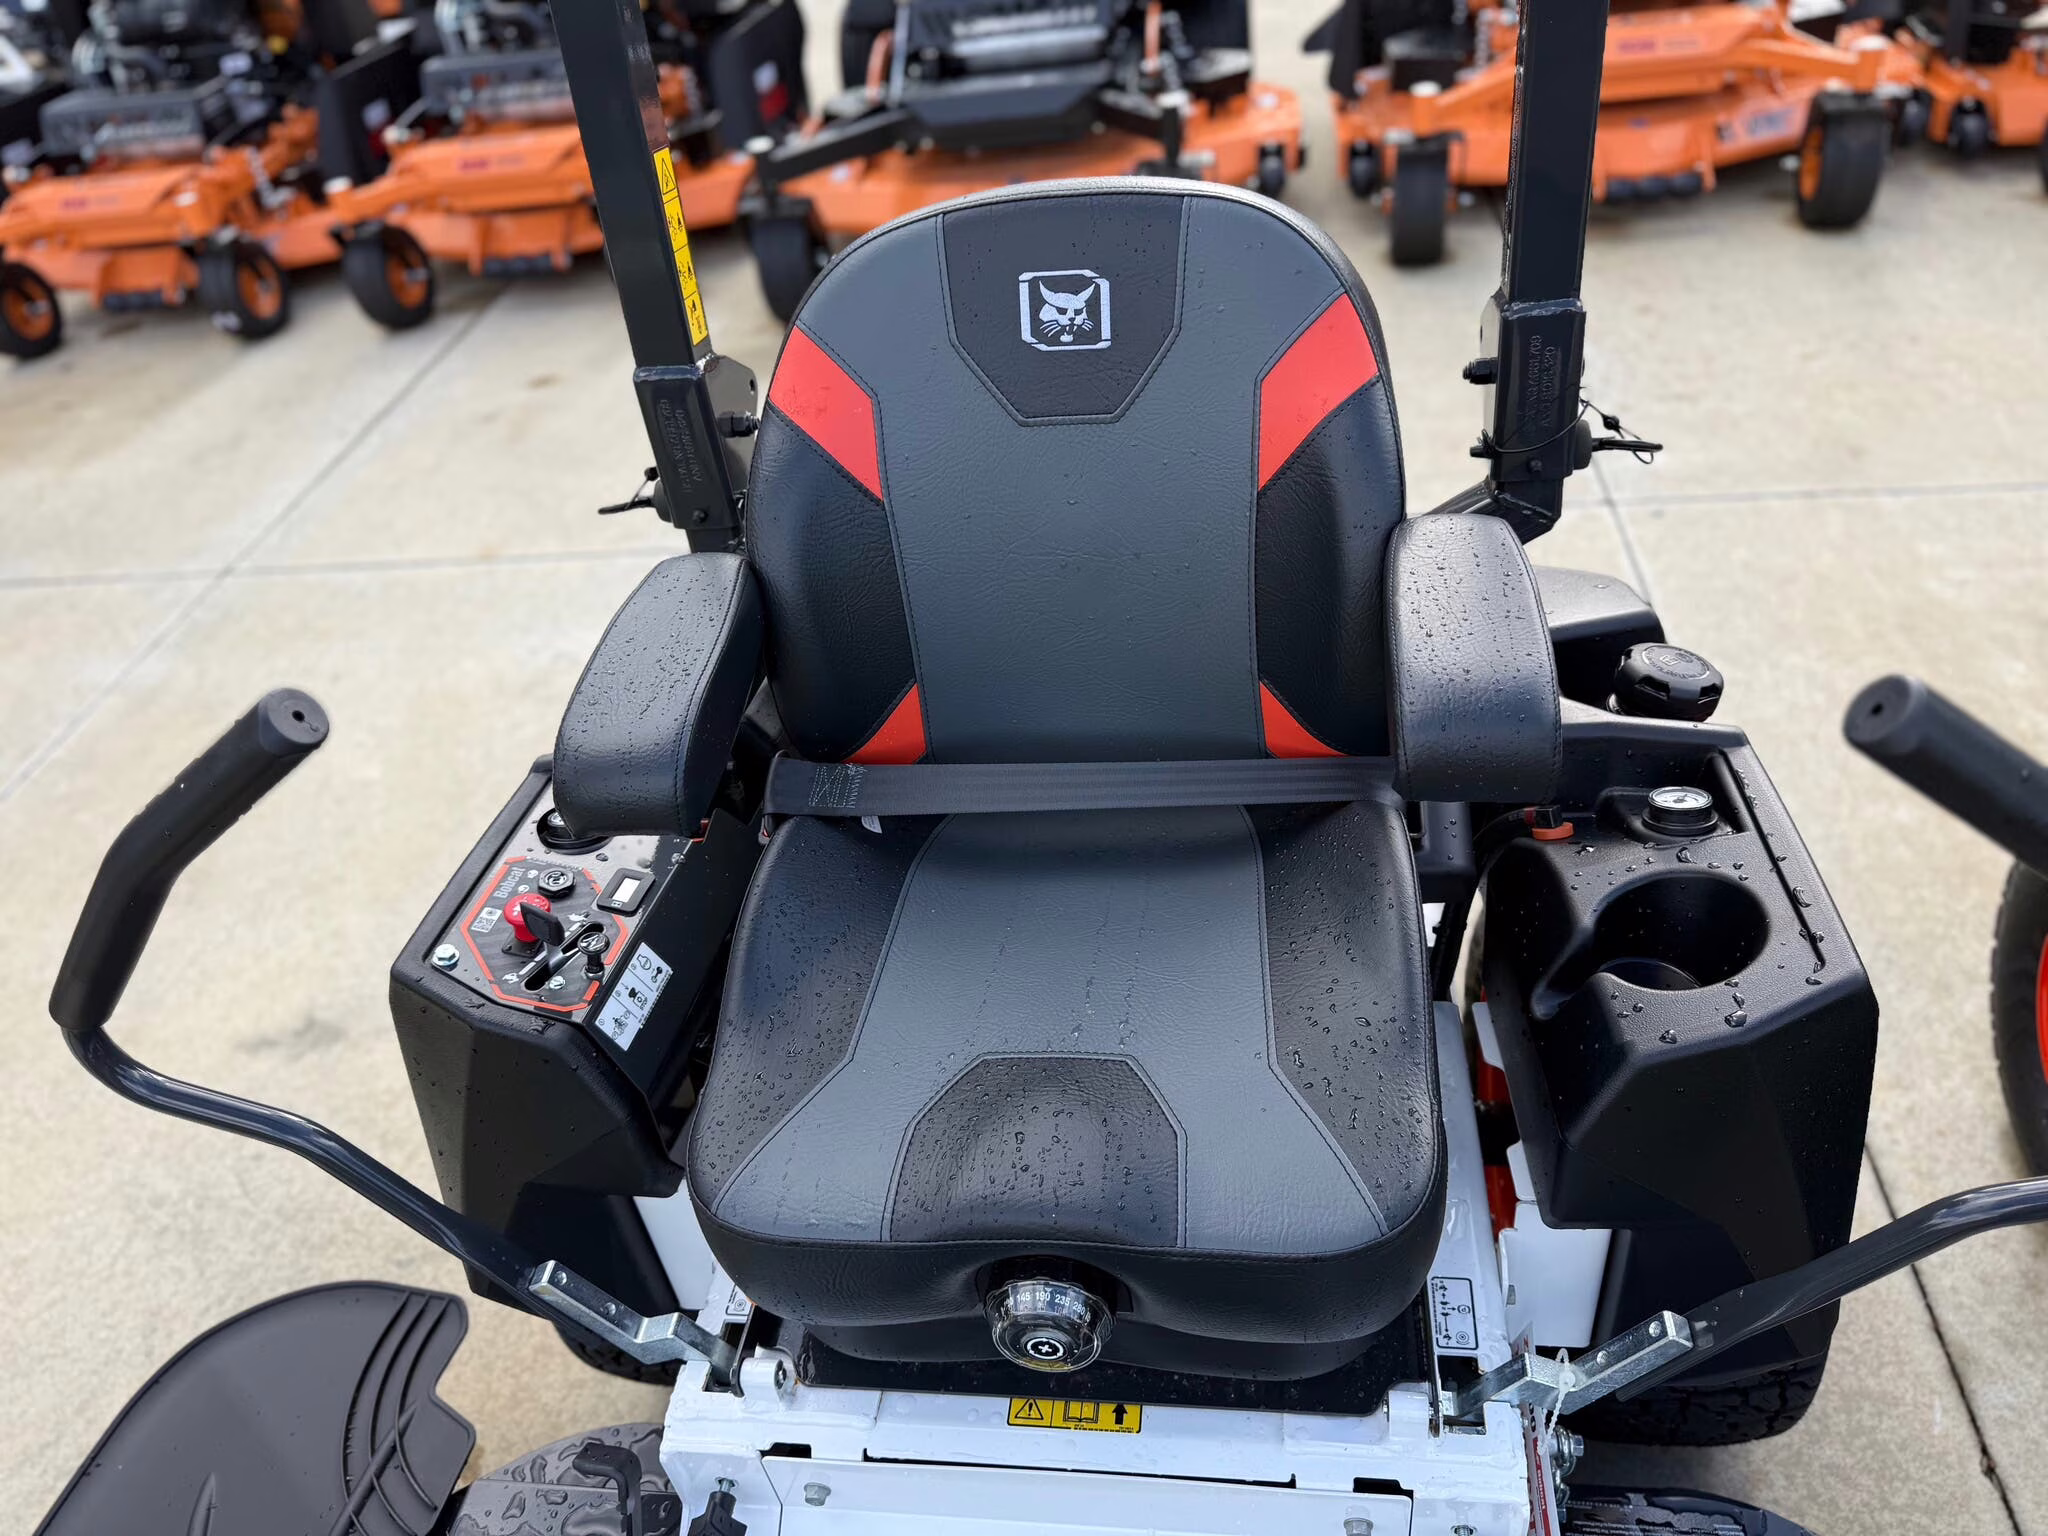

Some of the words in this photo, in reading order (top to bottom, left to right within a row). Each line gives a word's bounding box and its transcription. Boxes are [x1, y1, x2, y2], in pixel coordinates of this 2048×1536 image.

[493, 867, 525, 899] Bobcat
[1016, 1291, 1031, 1303] 145
[1035, 1291, 1051, 1302] 190
[1054, 1294, 1071, 1306] 235
[1072, 1301, 1086, 1316] 280
